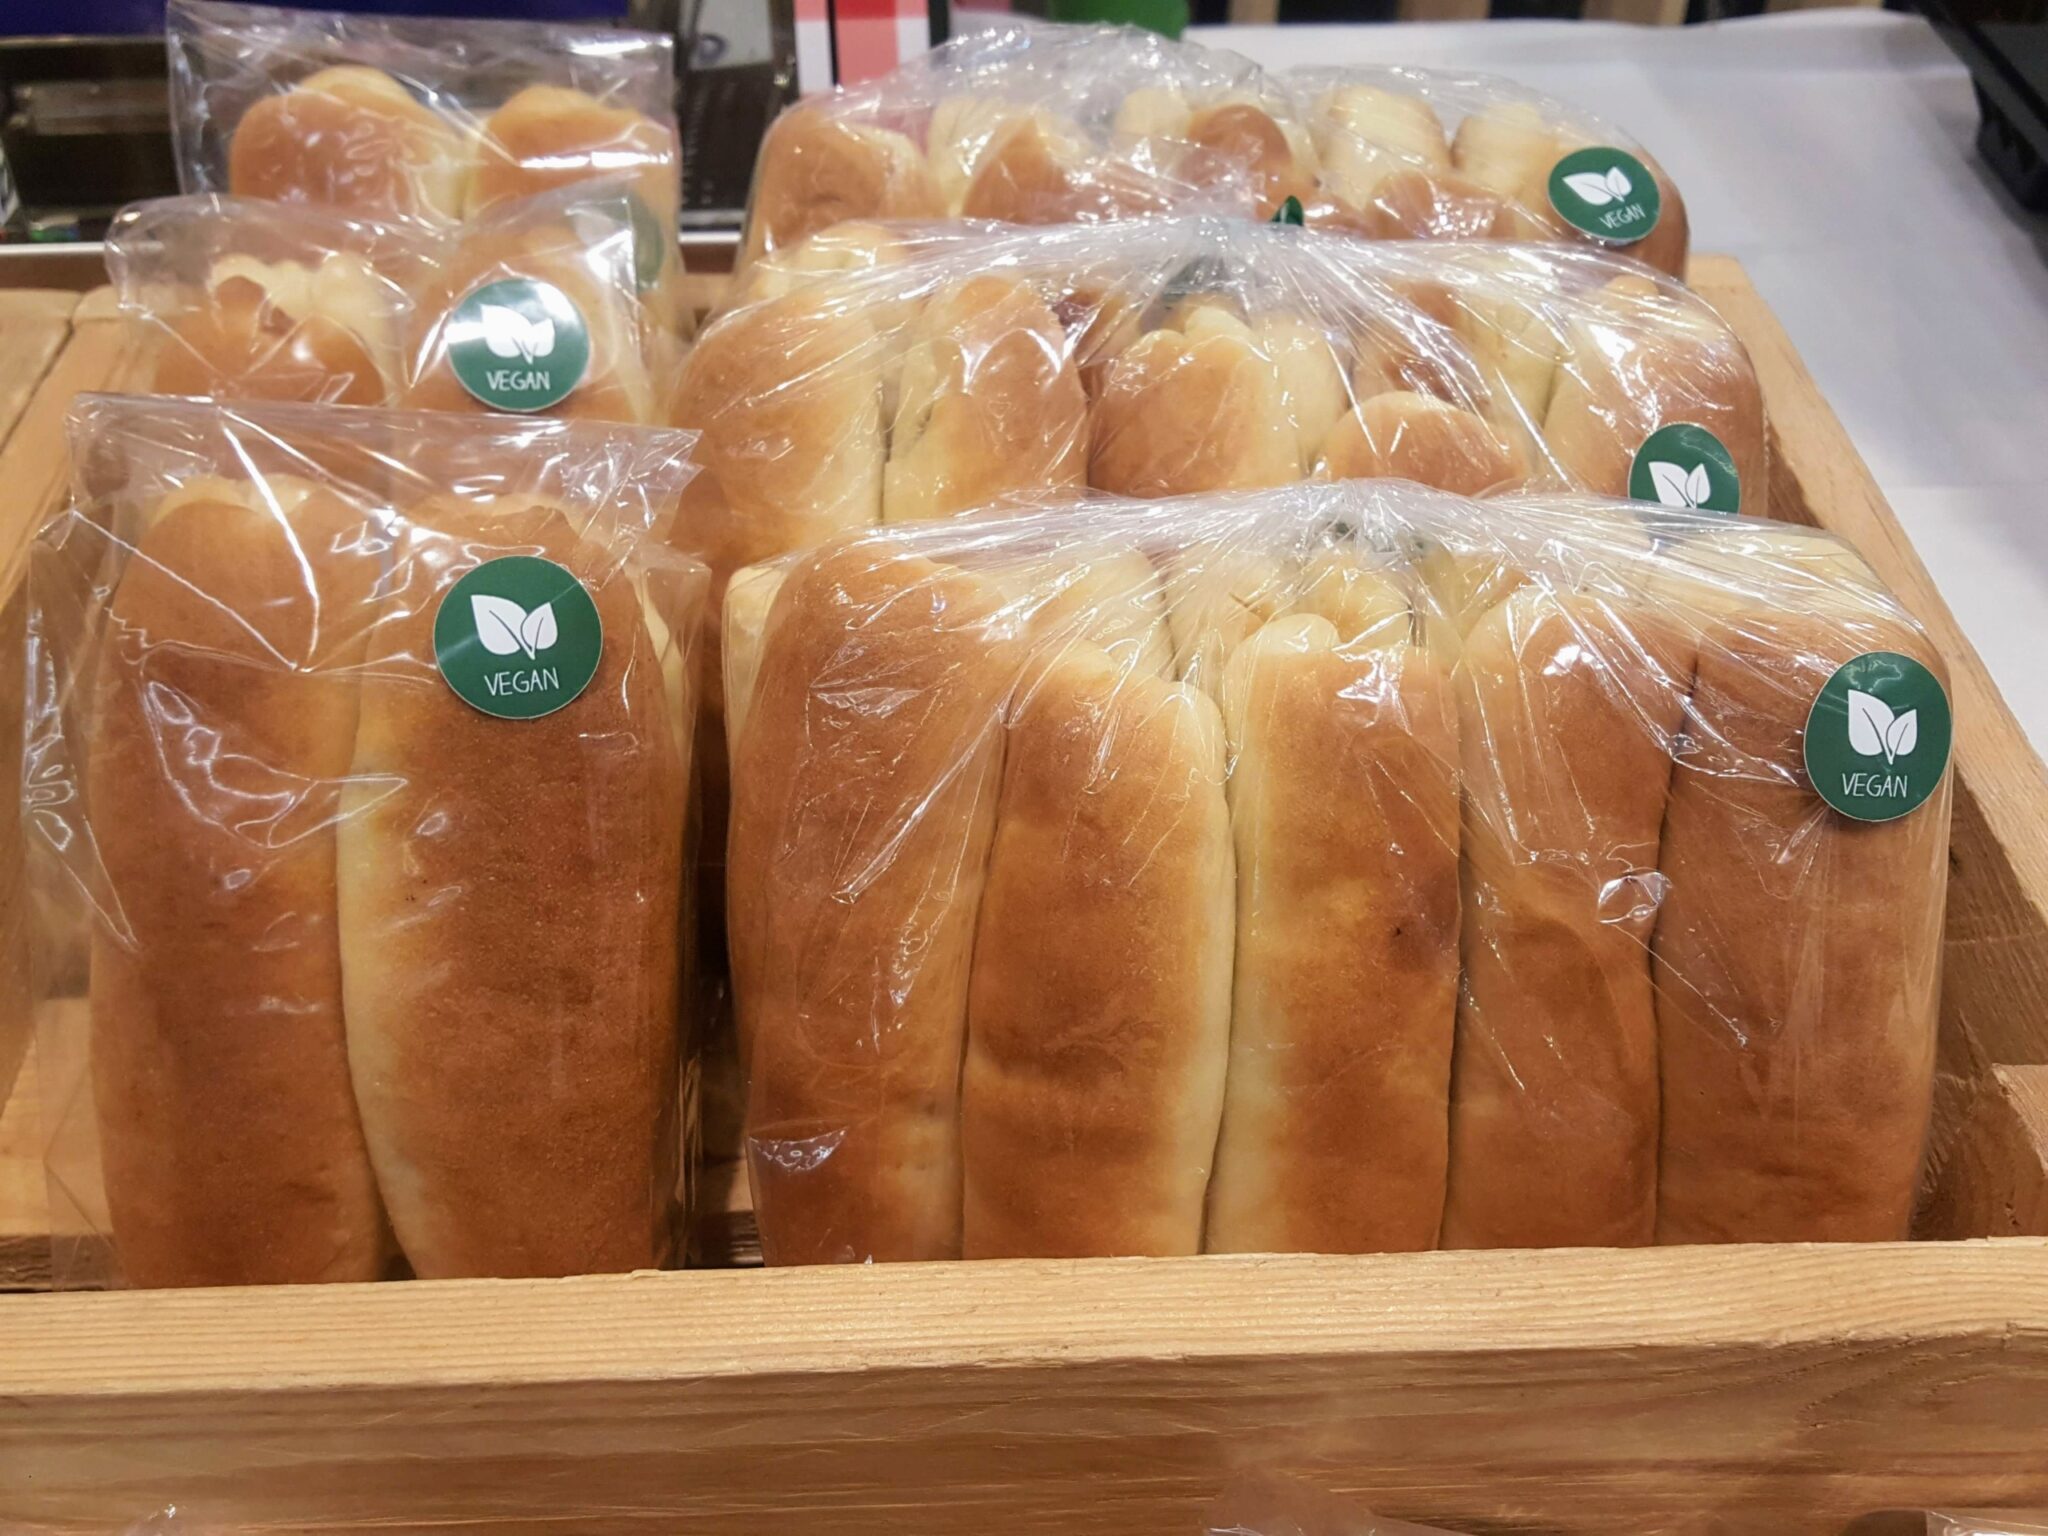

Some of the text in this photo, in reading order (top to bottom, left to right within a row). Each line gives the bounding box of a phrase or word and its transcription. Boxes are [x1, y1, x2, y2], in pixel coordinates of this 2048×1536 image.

[1598, 203, 1646, 229] VEGAN
[486, 369, 550, 391] VEGAN
[484, 667, 559, 696] VEGAN
[1842, 773, 1908, 798] VEGAN
